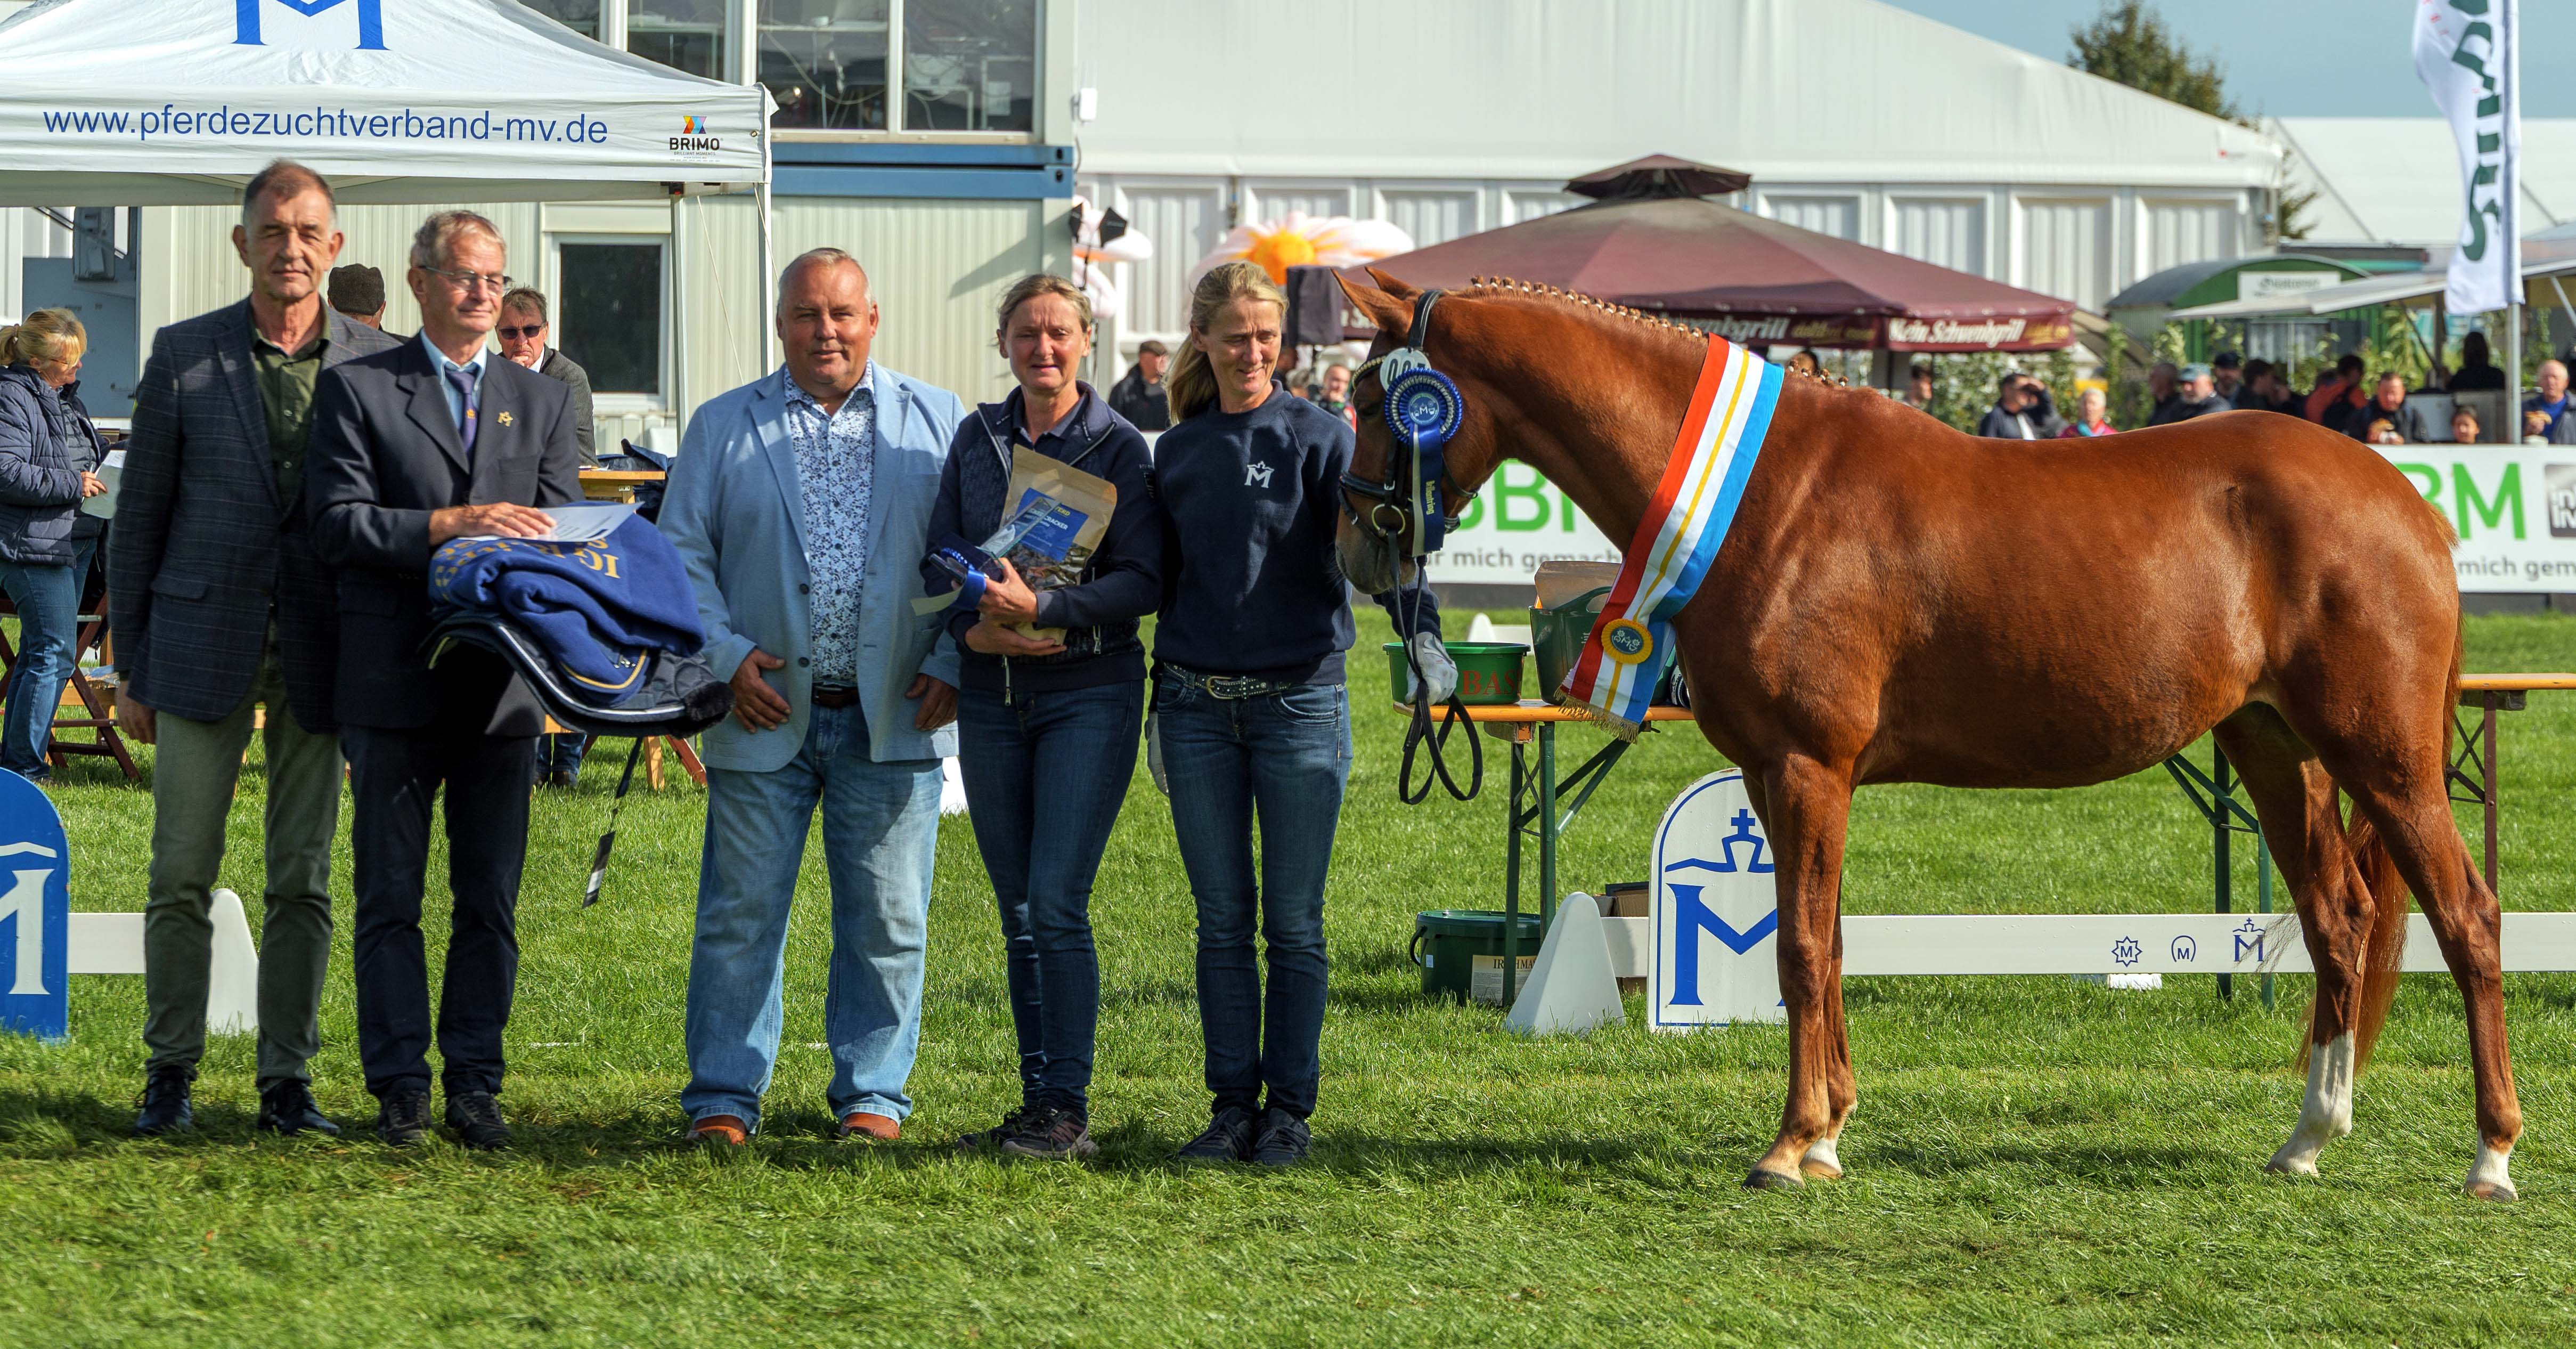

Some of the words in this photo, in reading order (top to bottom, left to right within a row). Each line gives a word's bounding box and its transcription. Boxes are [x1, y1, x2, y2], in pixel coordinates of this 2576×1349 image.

[44, 104, 608, 144] www.pferdezuchtverband-mv.de
[670, 137, 720, 151] BRIMO
[1453, 548, 1513, 567] mich
[2458, 555, 2517, 576] mich
[2120, 946, 2133, 957] M
[2177, 947, 2190, 960] M
